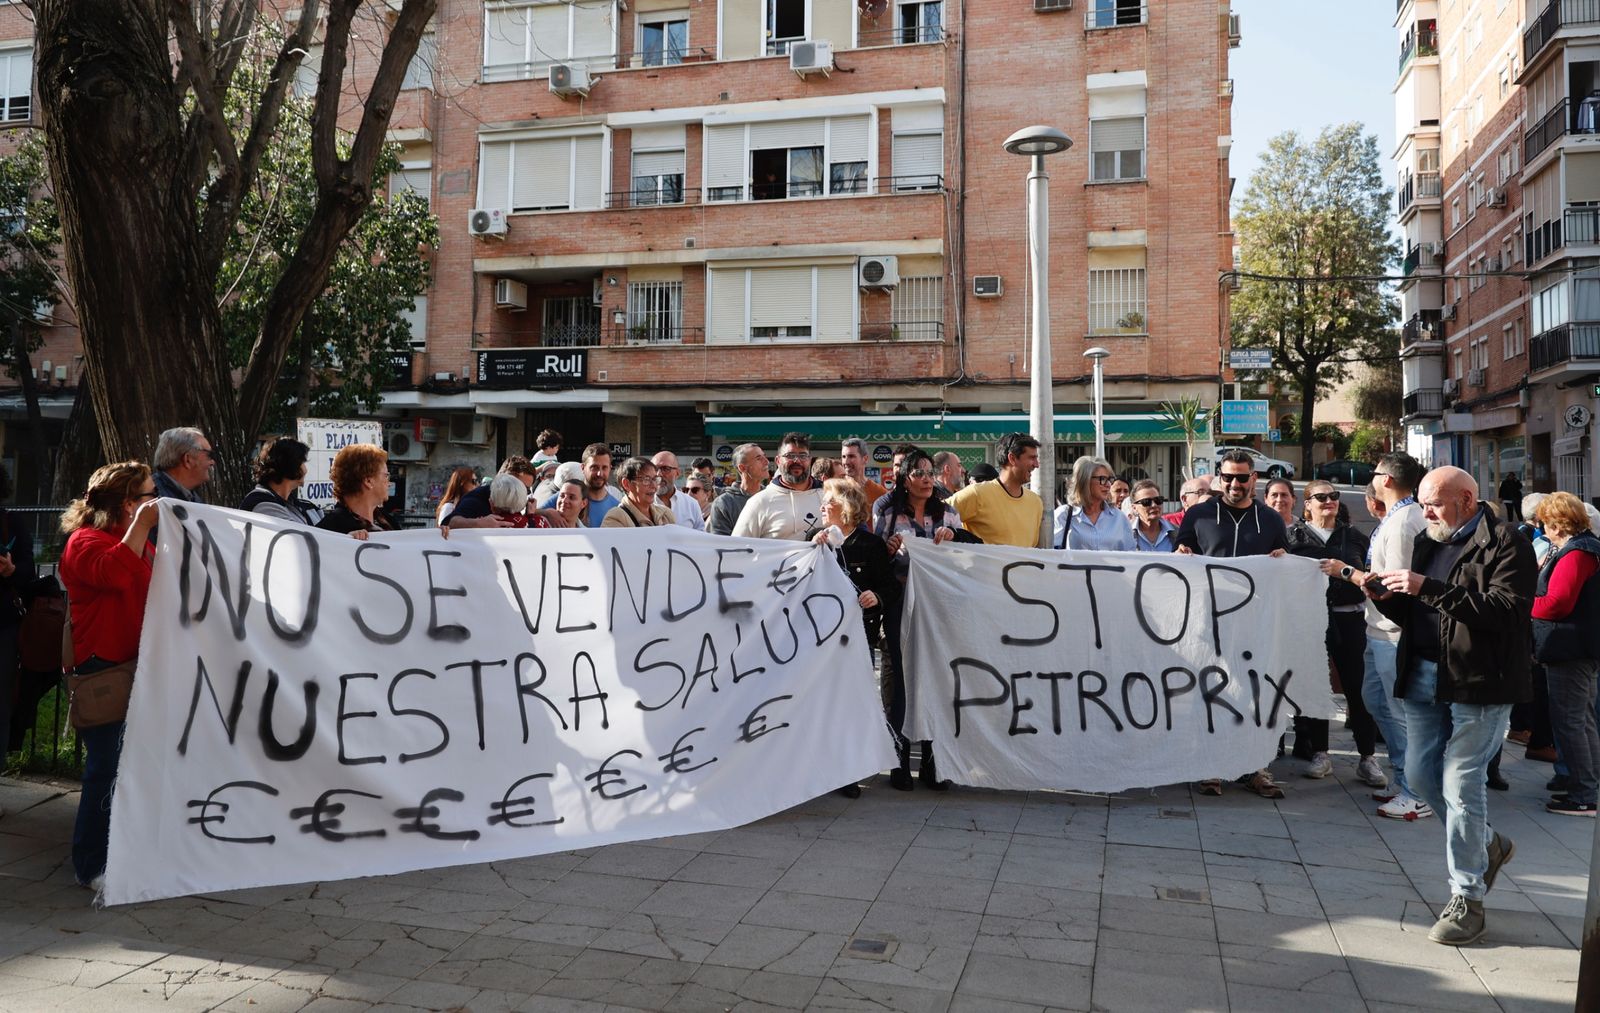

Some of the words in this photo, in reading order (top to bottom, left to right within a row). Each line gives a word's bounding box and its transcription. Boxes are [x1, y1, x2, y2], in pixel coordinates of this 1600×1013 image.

[479, 353, 487, 380] DENTAL
[539, 355, 582, 375] Rull
[1270, 431, 1278, 439] P
[611, 444, 631, 455] Rull
[307, 483, 334, 499] CONS
[349, 542, 471, 645] SE
[503, 547, 754, 634] VENDE
[177, 651, 609, 765] NUESTRA
